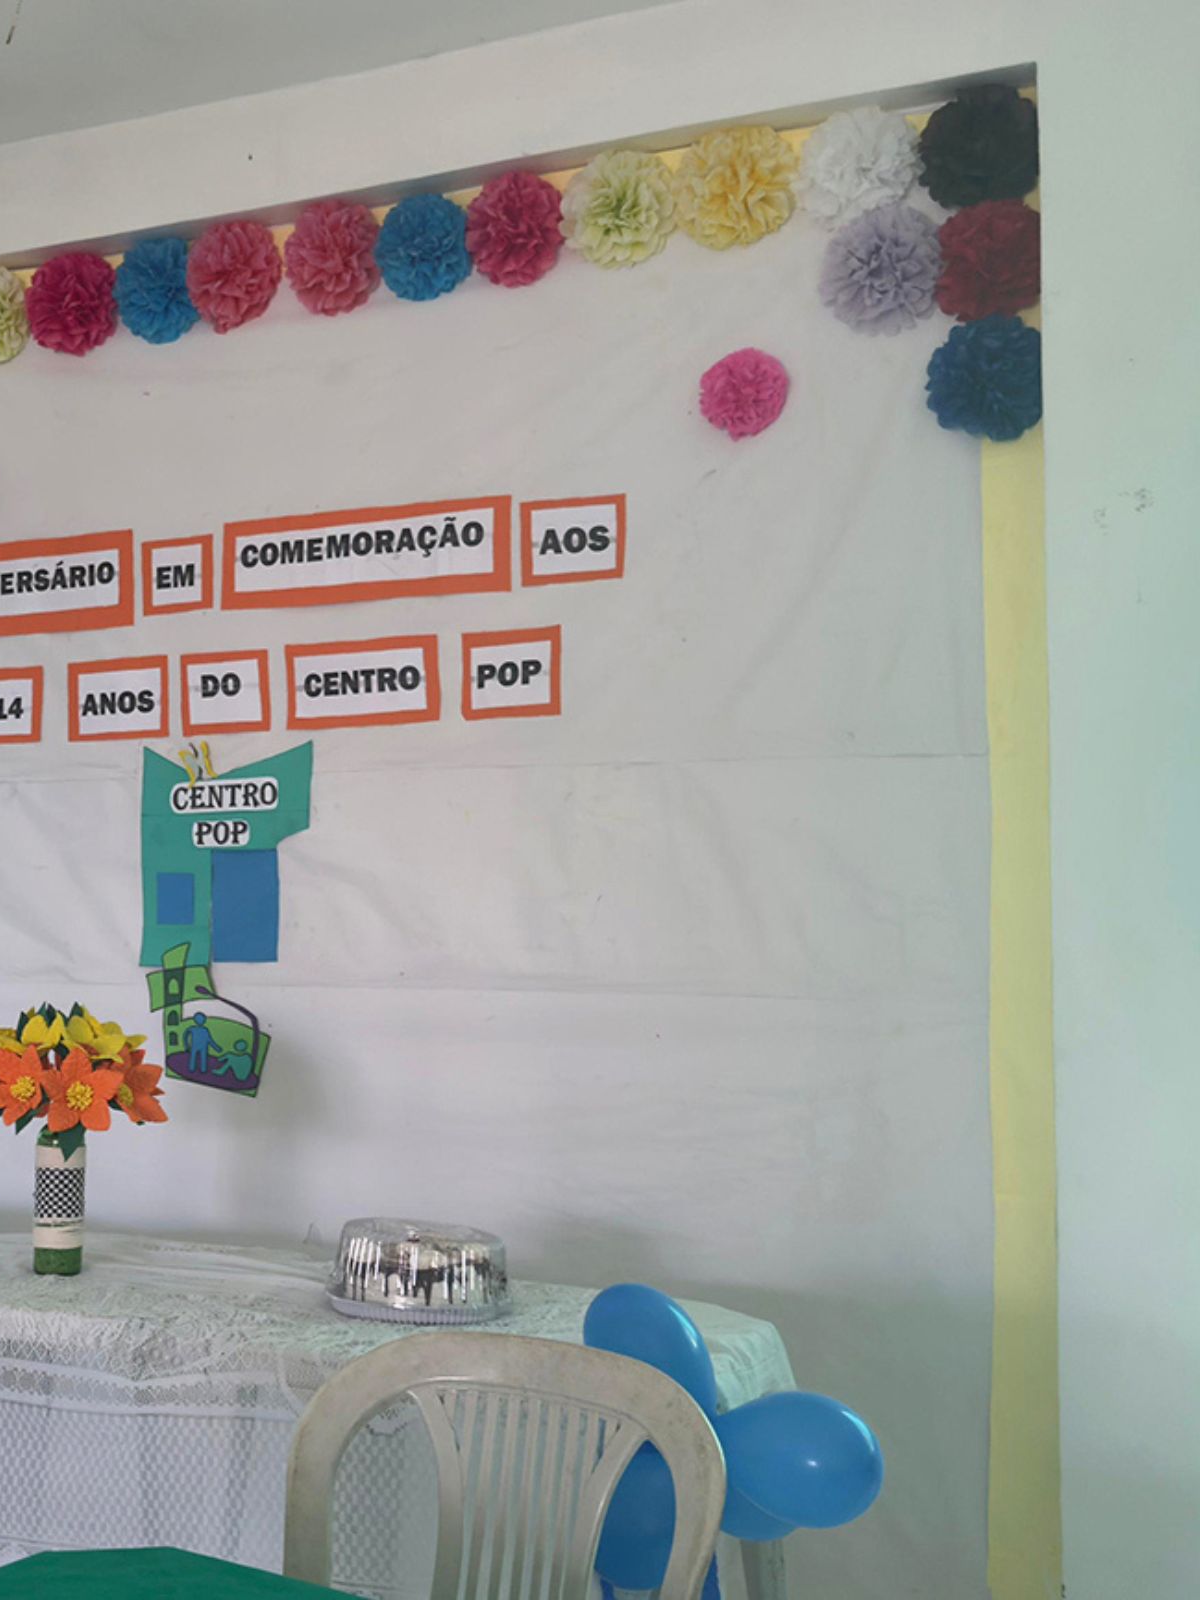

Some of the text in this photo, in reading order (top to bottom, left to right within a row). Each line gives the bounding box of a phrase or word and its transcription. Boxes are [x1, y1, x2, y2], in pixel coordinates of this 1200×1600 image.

[155, 564, 195, 590] EM
[240, 517, 485, 568] COMEMORAÇÃO
[539, 525, 611, 555] AOS
[81, 690, 155, 717] ANOS
[201, 673, 241, 698] DO
[303, 665, 421, 698] CENTRO
[476, 659, 542, 689] POP
[172, 780, 278, 811] CENTRO
[195, 821, 249, 846] POP
